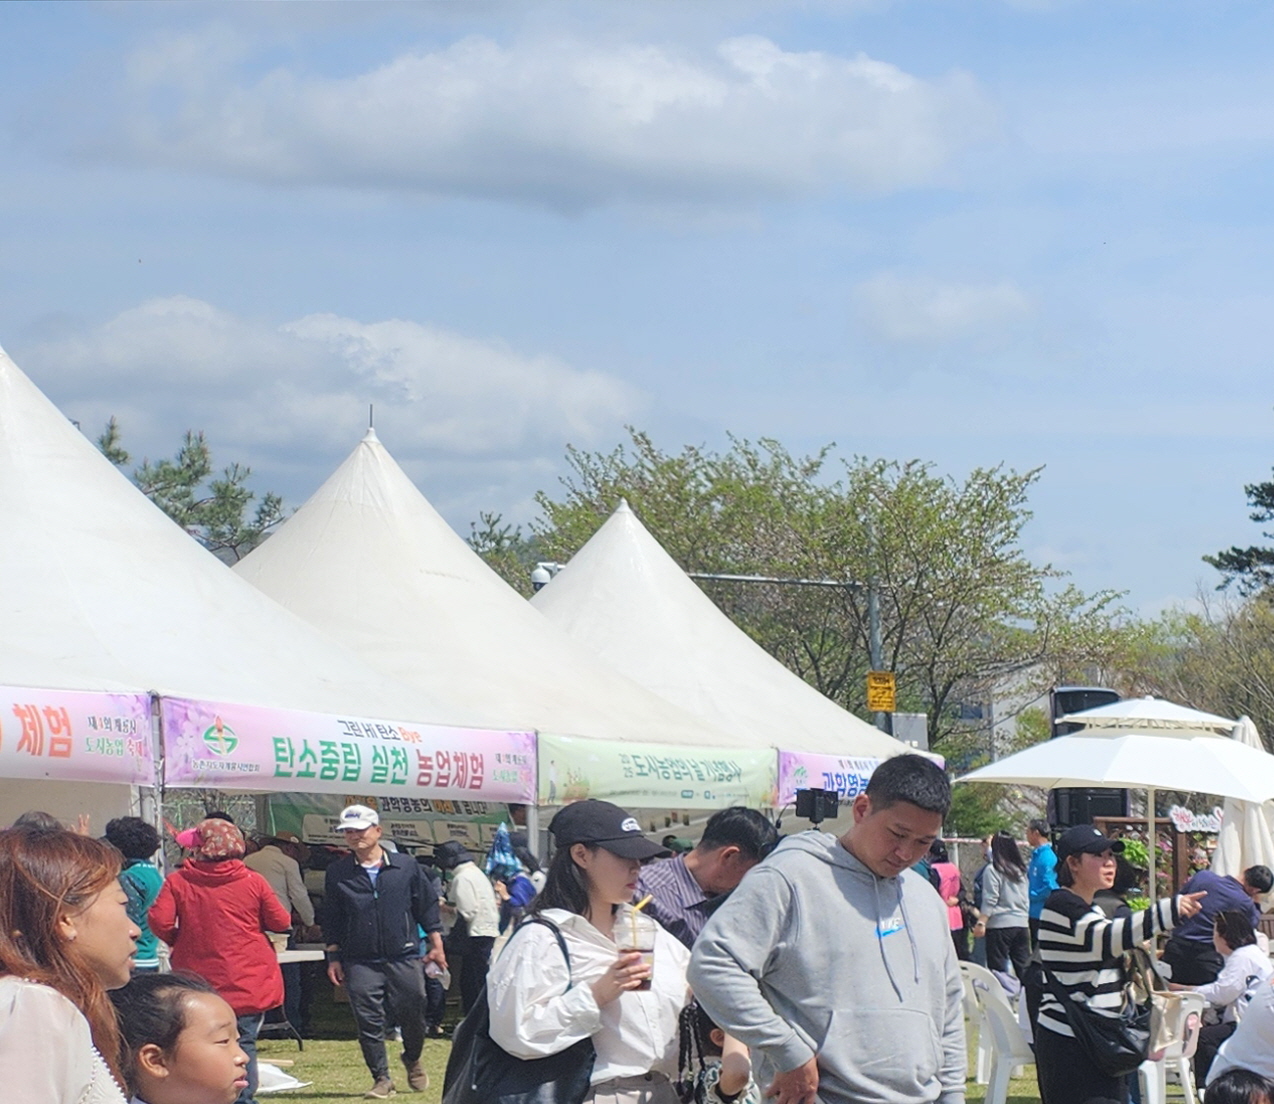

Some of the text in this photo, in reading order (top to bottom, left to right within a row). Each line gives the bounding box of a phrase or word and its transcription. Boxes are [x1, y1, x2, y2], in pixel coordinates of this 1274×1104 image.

[12, 703, 73, 758] 체험
[375, 724, 401, 741] 탄소
[86, 737, 124, 757] 도시농업
[272, 737, 485, 790] 탄소중립 실천 농업체험
[631, 754, 694, 781] 도시농업의
